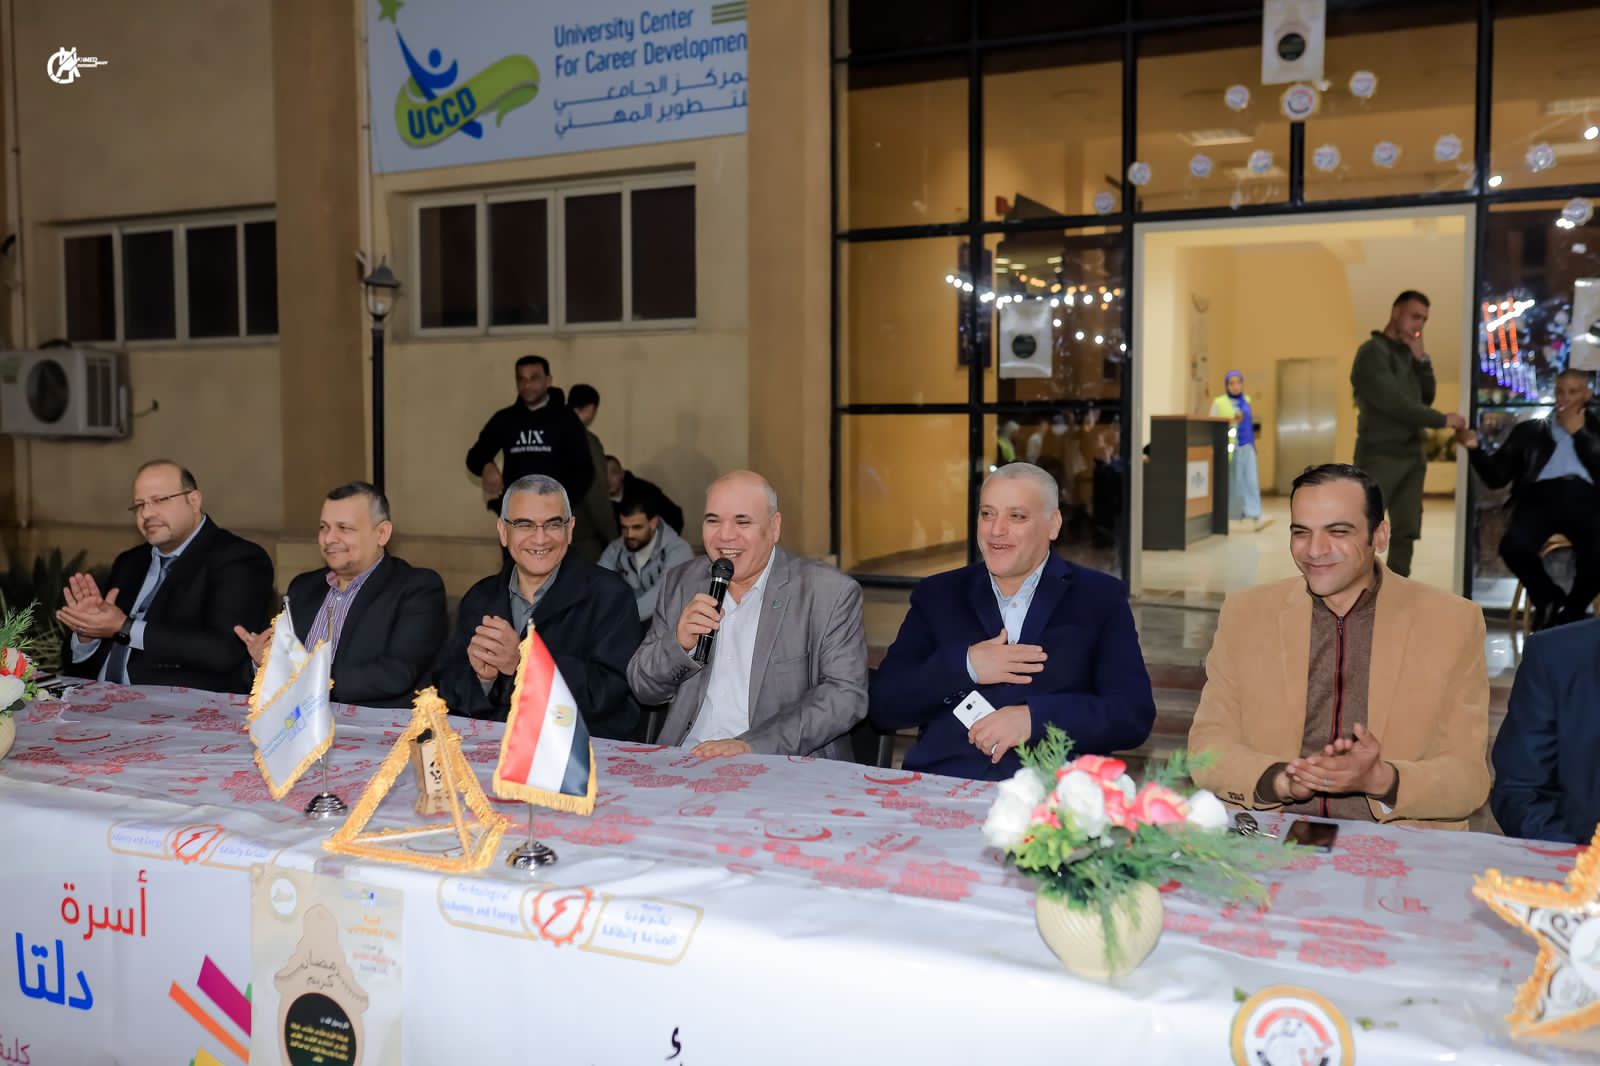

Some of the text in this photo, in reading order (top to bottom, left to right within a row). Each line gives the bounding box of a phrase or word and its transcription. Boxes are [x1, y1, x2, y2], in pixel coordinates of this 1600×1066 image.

[554, 9, 694, 48] University Center
[555, 32, 748, 78] For Career Developmen
[672, 66, 749, 97] مركز
[408, 87, 477, 139] UCCD
[554, 88, 749, 140] لتطوير المهني
[61, 869, 147, 940] أسرة
[15, 932, 94, 1011] دلتا
